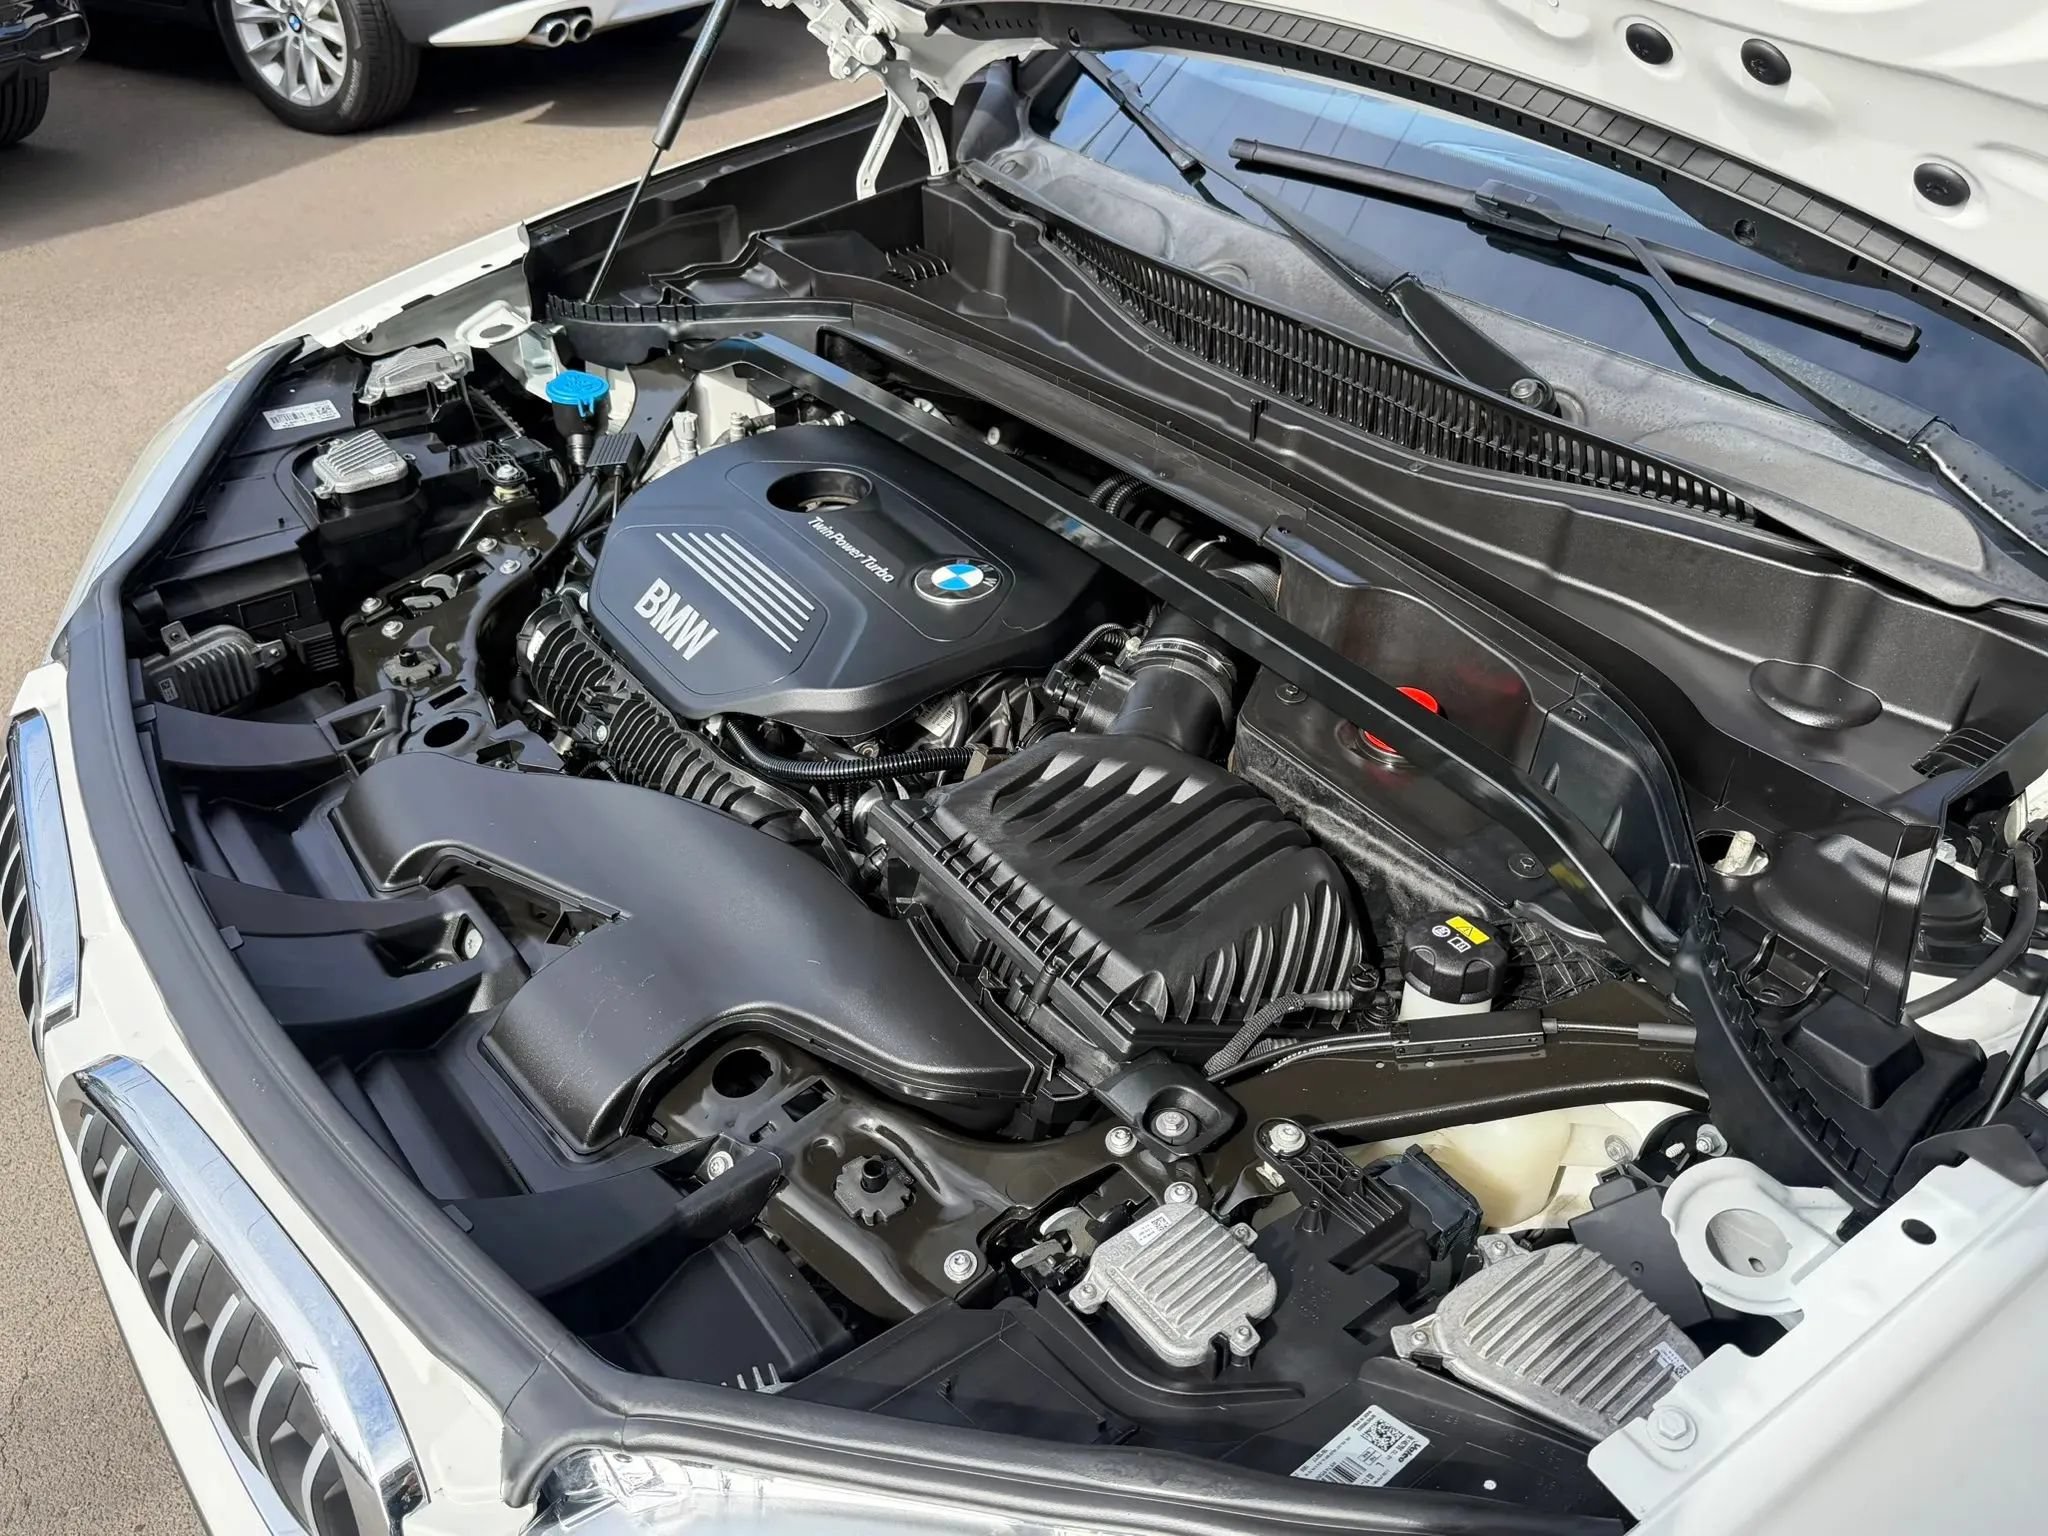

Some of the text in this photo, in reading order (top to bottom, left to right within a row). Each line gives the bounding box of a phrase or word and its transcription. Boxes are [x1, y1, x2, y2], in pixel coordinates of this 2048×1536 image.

[808, 516, 895, 583] TwinPower Turbo
[633, 577, 719, 661] BMW
[1398, 1442, 1421, 1463] Valeo
